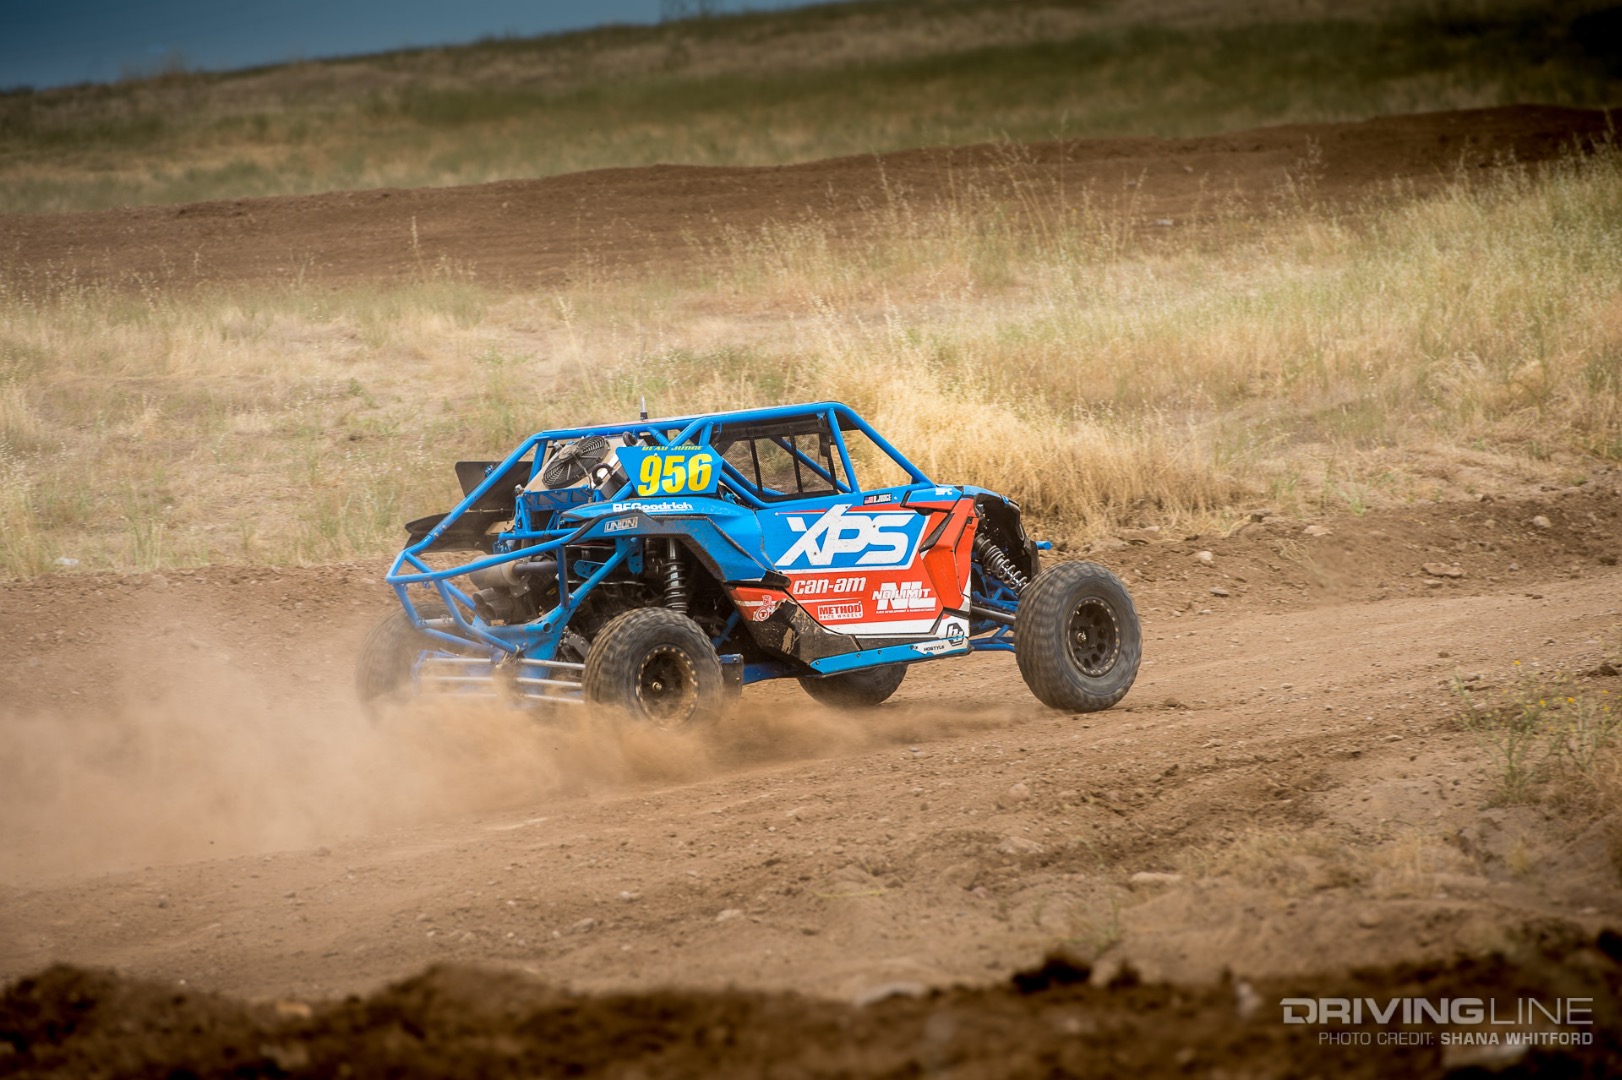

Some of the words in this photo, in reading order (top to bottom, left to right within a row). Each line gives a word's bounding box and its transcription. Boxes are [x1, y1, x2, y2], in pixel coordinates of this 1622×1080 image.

[638, 454, 712, 496] 956
[612, 502, 693, 512] BFGoodrich
[606, 518, 636, 532] UNION
[775, 504, 916, 566] XPS
[792, 577, 866, 594] can-am
[872, 590, 892, 600] NO
[894, 588, 931, 600] LIMIT
[819, 605, 860, 614] METHOD
